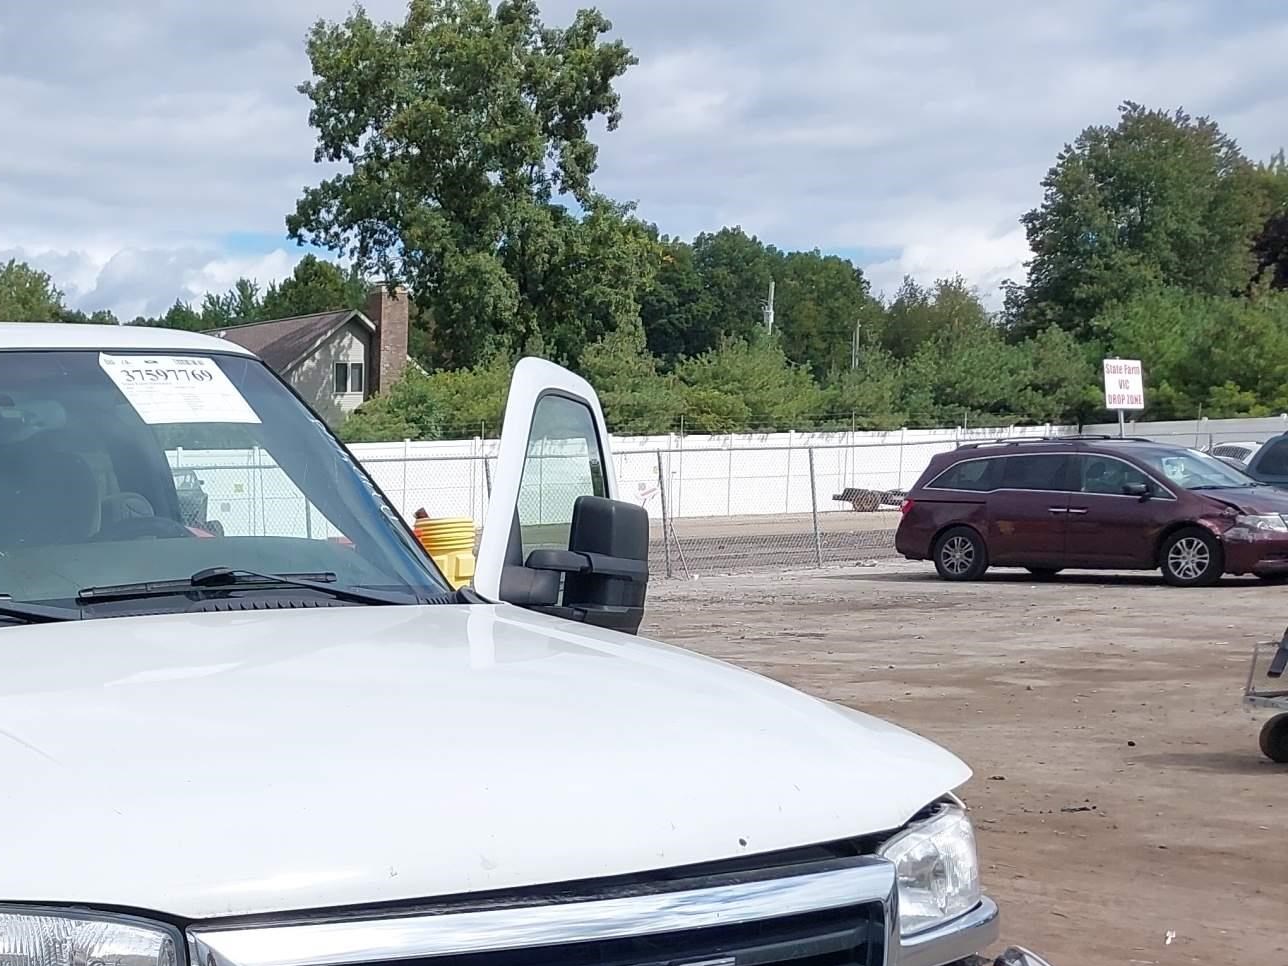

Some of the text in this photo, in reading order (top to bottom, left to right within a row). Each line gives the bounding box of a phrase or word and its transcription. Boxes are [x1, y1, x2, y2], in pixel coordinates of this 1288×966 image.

[1105, 363, 1140, 375] State Farm
[120, 369, 214, 383] 37597769
